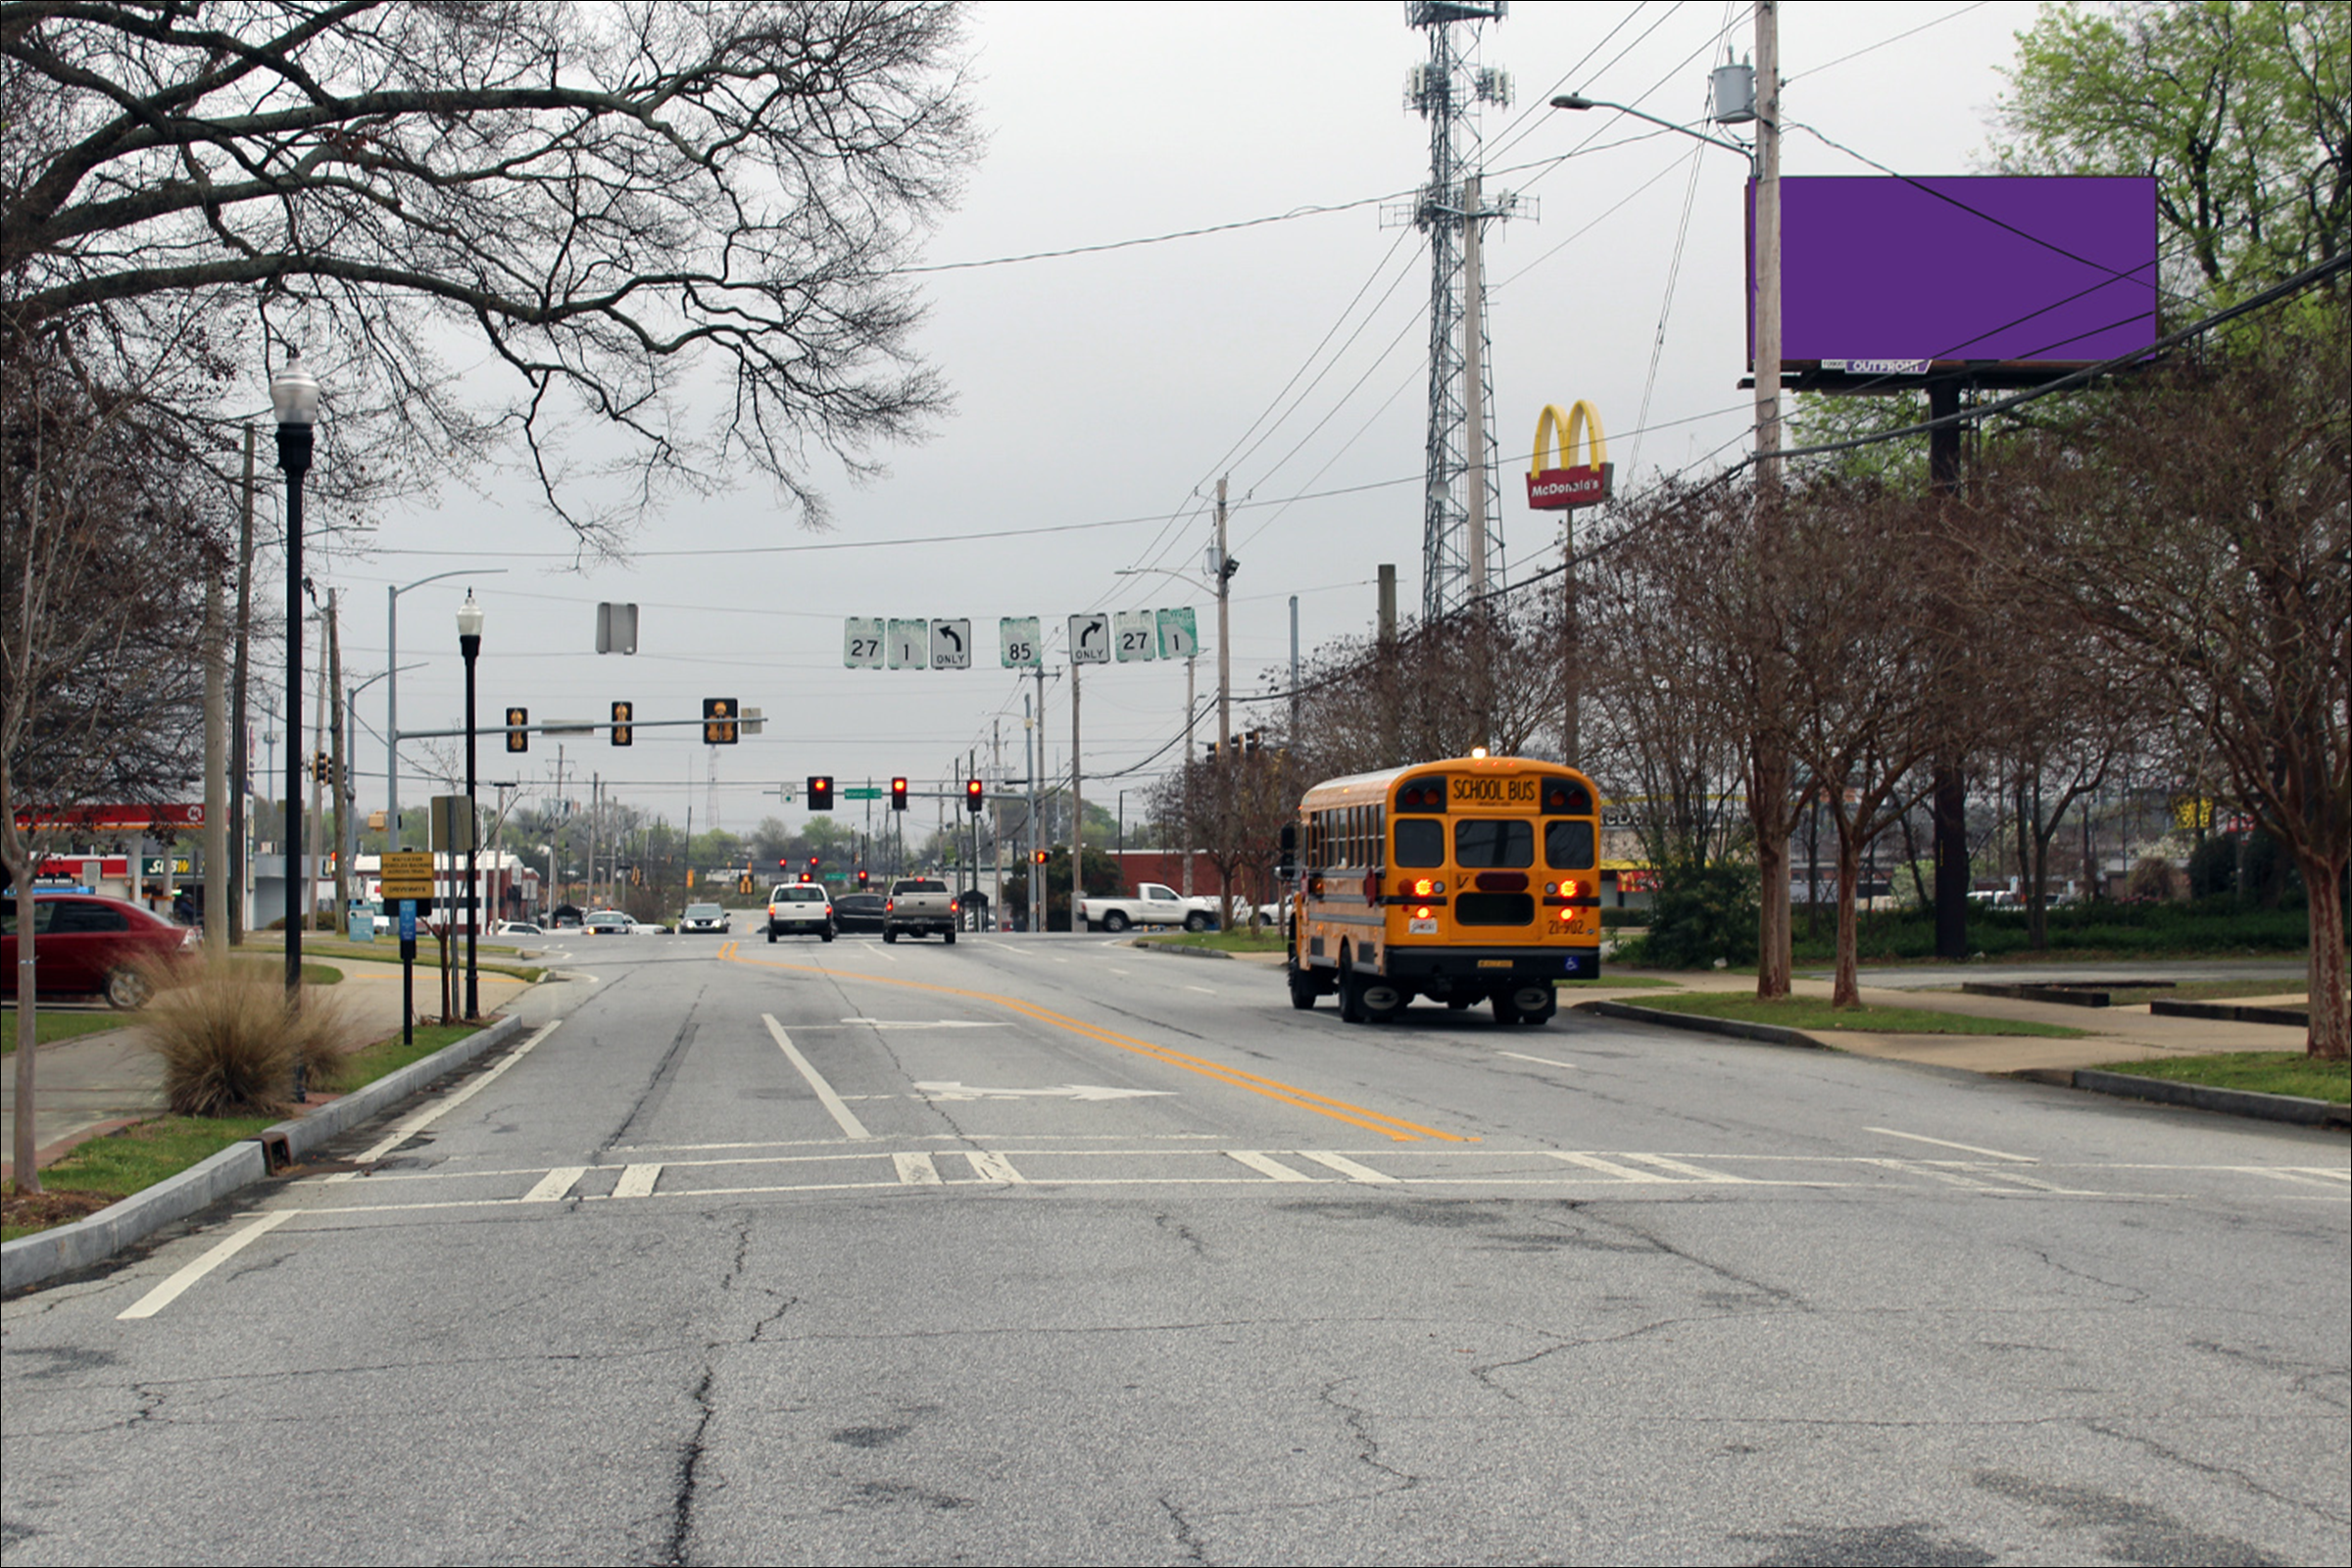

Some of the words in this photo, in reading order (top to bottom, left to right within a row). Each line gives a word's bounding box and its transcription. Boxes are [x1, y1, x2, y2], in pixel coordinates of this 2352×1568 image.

[1852, 360, 1920, 371] OUTFRONT
[1532, 478, 1599, 497] McDonald's
[851, 639, 878, 658] 27
[1123, 632, 1148, 651] 27
[1173, 633, 1179, 651] 1
[904, 643, 909, 661] 1
[936, 654, 965, 664] ONLY
[1008, 643, 1032, 661] 85
[1075, 649, 1103, 661] ONLY
[1453, 779, 1505, 800] SCHOOL
[1509, 780, 1536, 801] BUS
[1548, 919, 1585, 935] 21-902
